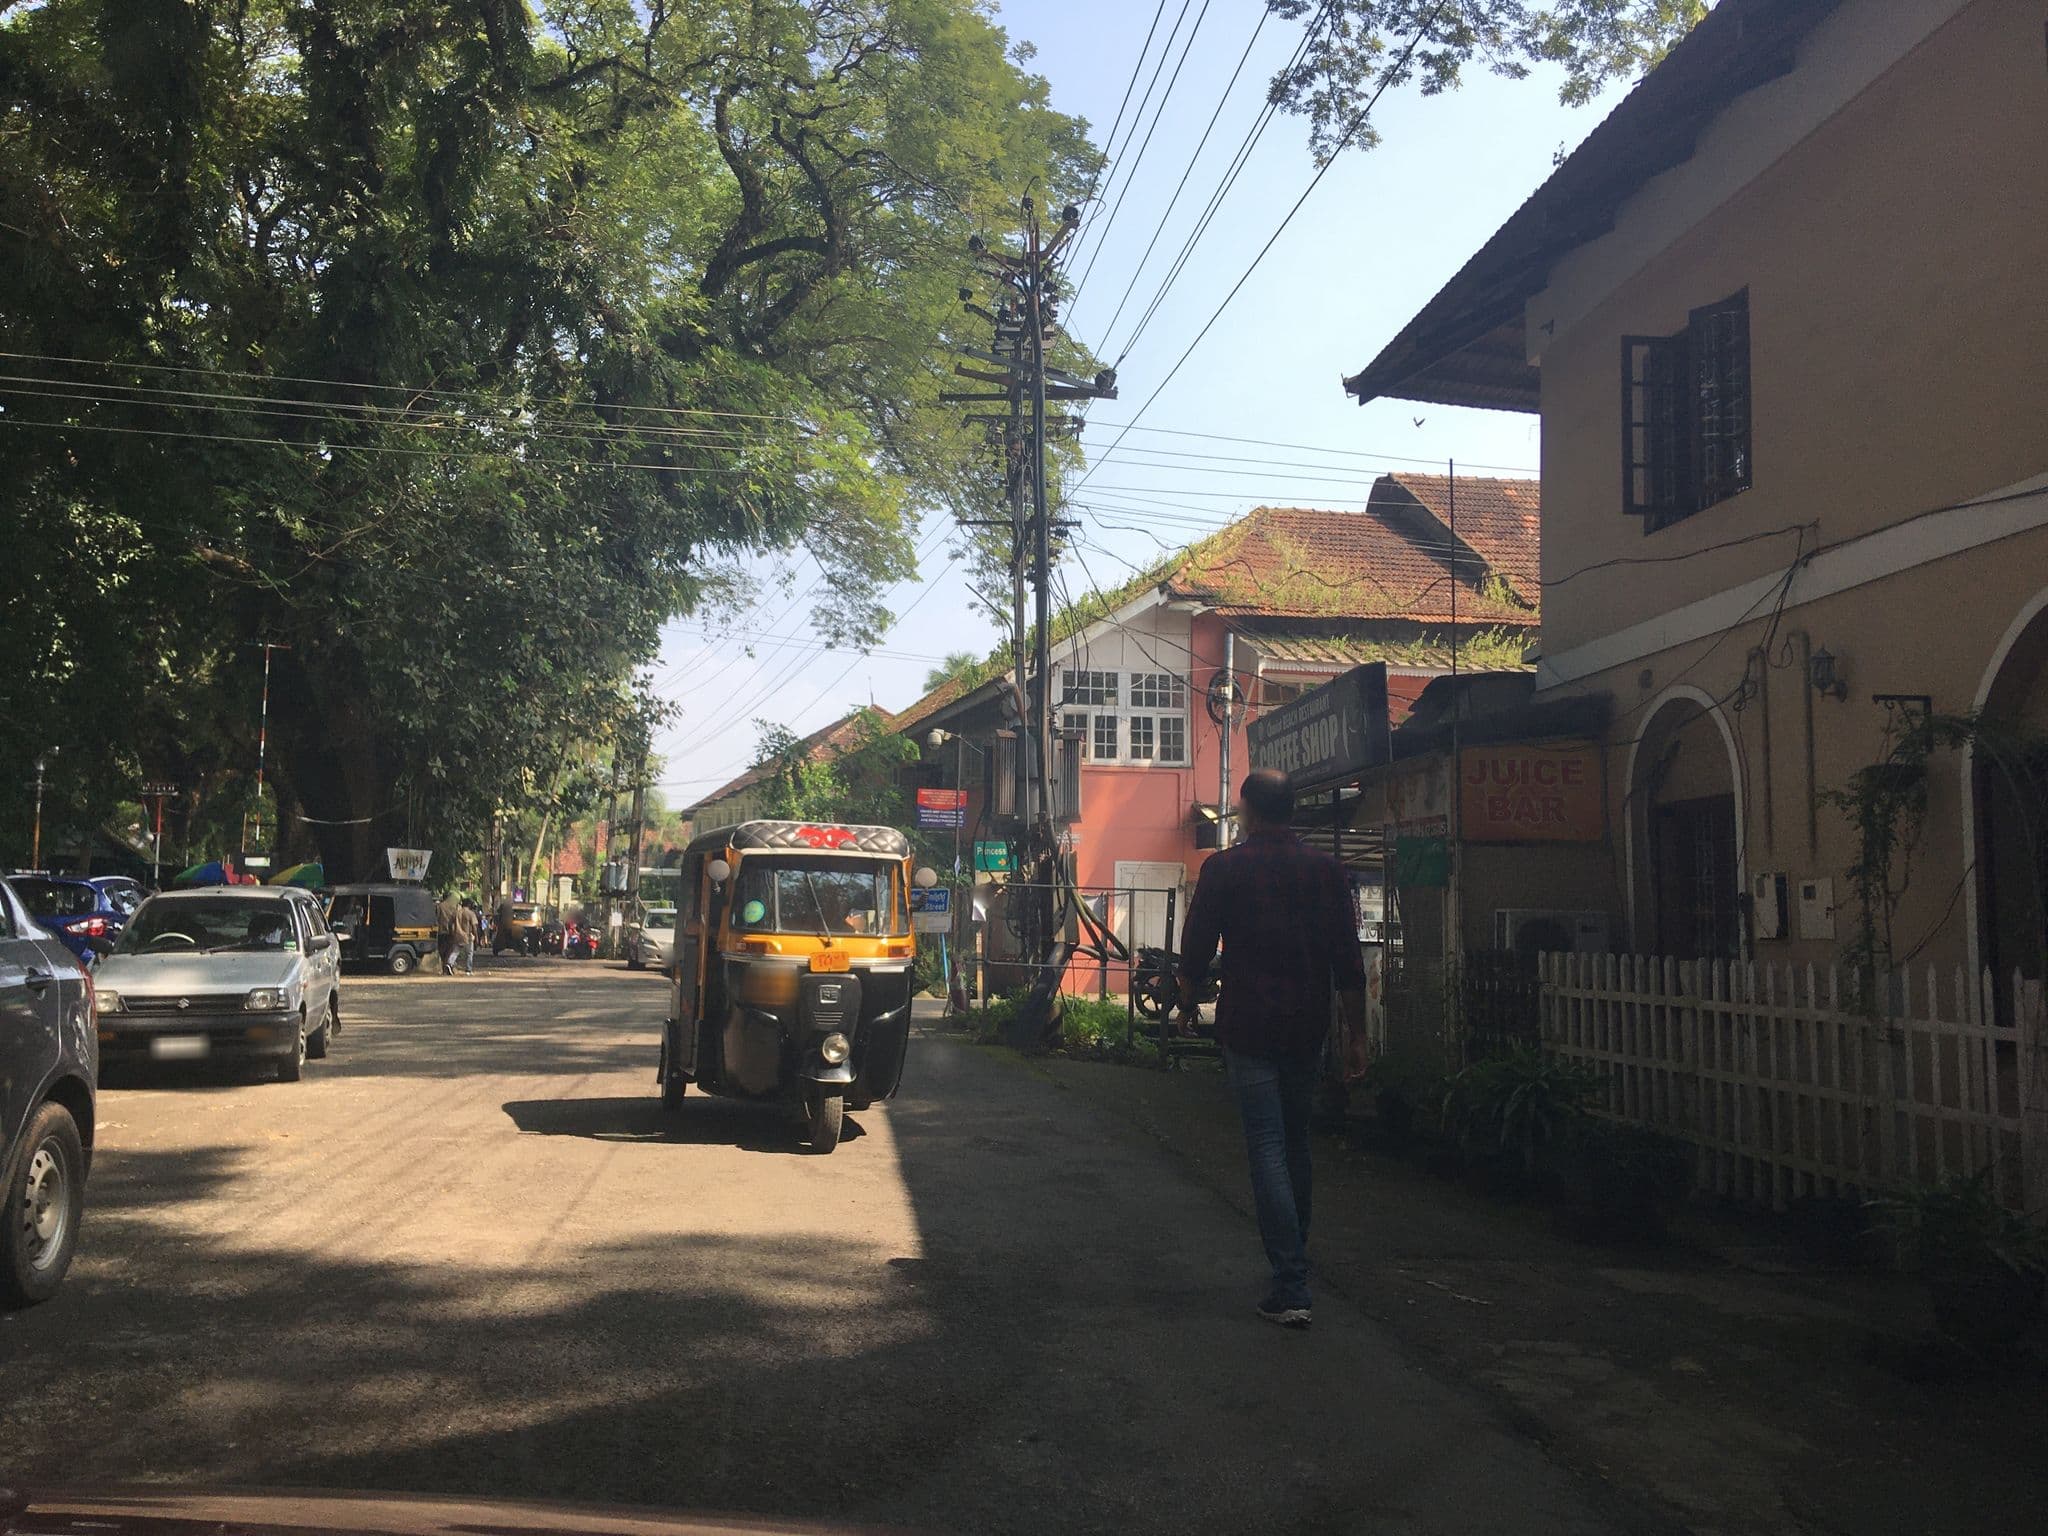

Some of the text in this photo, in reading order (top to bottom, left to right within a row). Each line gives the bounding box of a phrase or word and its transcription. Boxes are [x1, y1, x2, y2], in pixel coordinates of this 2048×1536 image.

[1258, 731, 1300, 772] COFFEE
[1301, 713, 1338, 767] SHOP
[1465, 758, 1584, 786] JUICE
[1487, 794, 1568, 824] BAR
[976, 846, 1007, 856] Pincess
